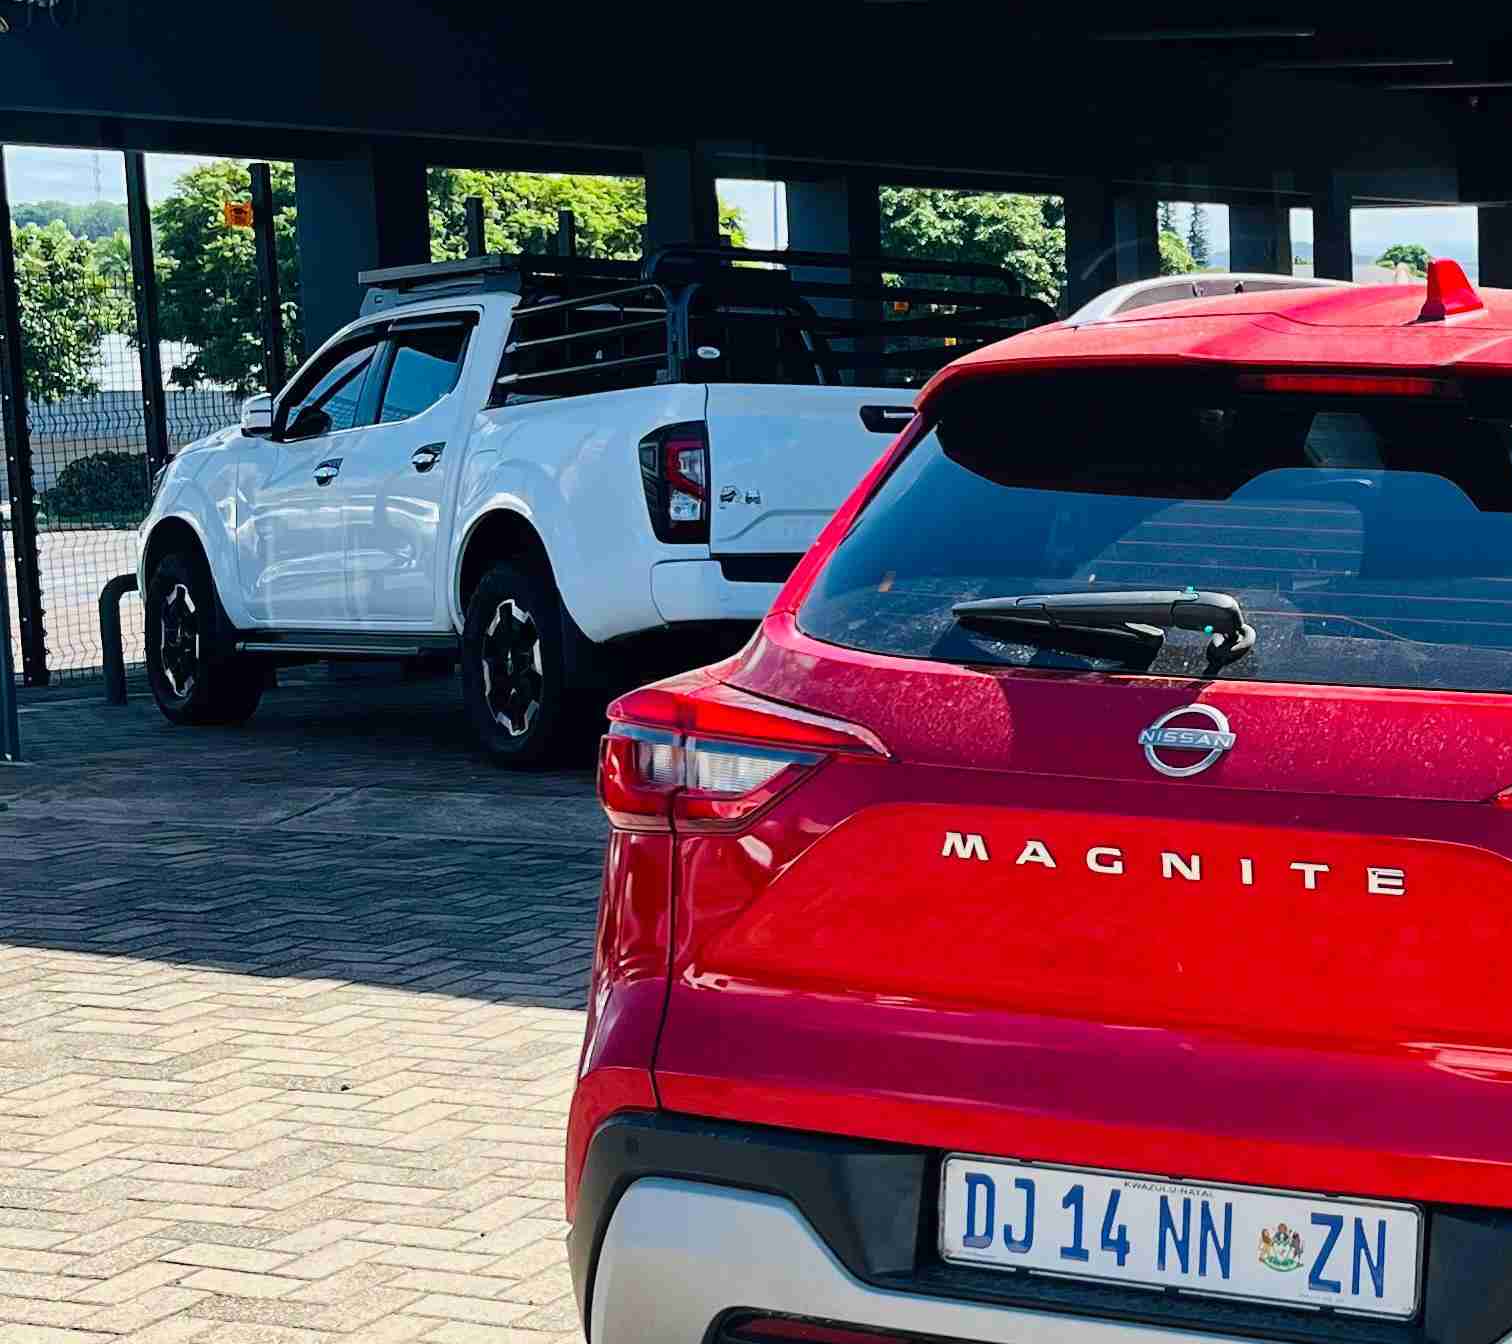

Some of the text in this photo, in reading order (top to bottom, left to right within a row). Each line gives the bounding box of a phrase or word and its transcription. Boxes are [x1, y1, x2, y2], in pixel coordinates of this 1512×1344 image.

[1142, 729, 1231, 748] NISSAN
[942, 831, 1406, 896] MAGNITE
[963, 1172, 1387, 1298] DJ 14 NN ZN
